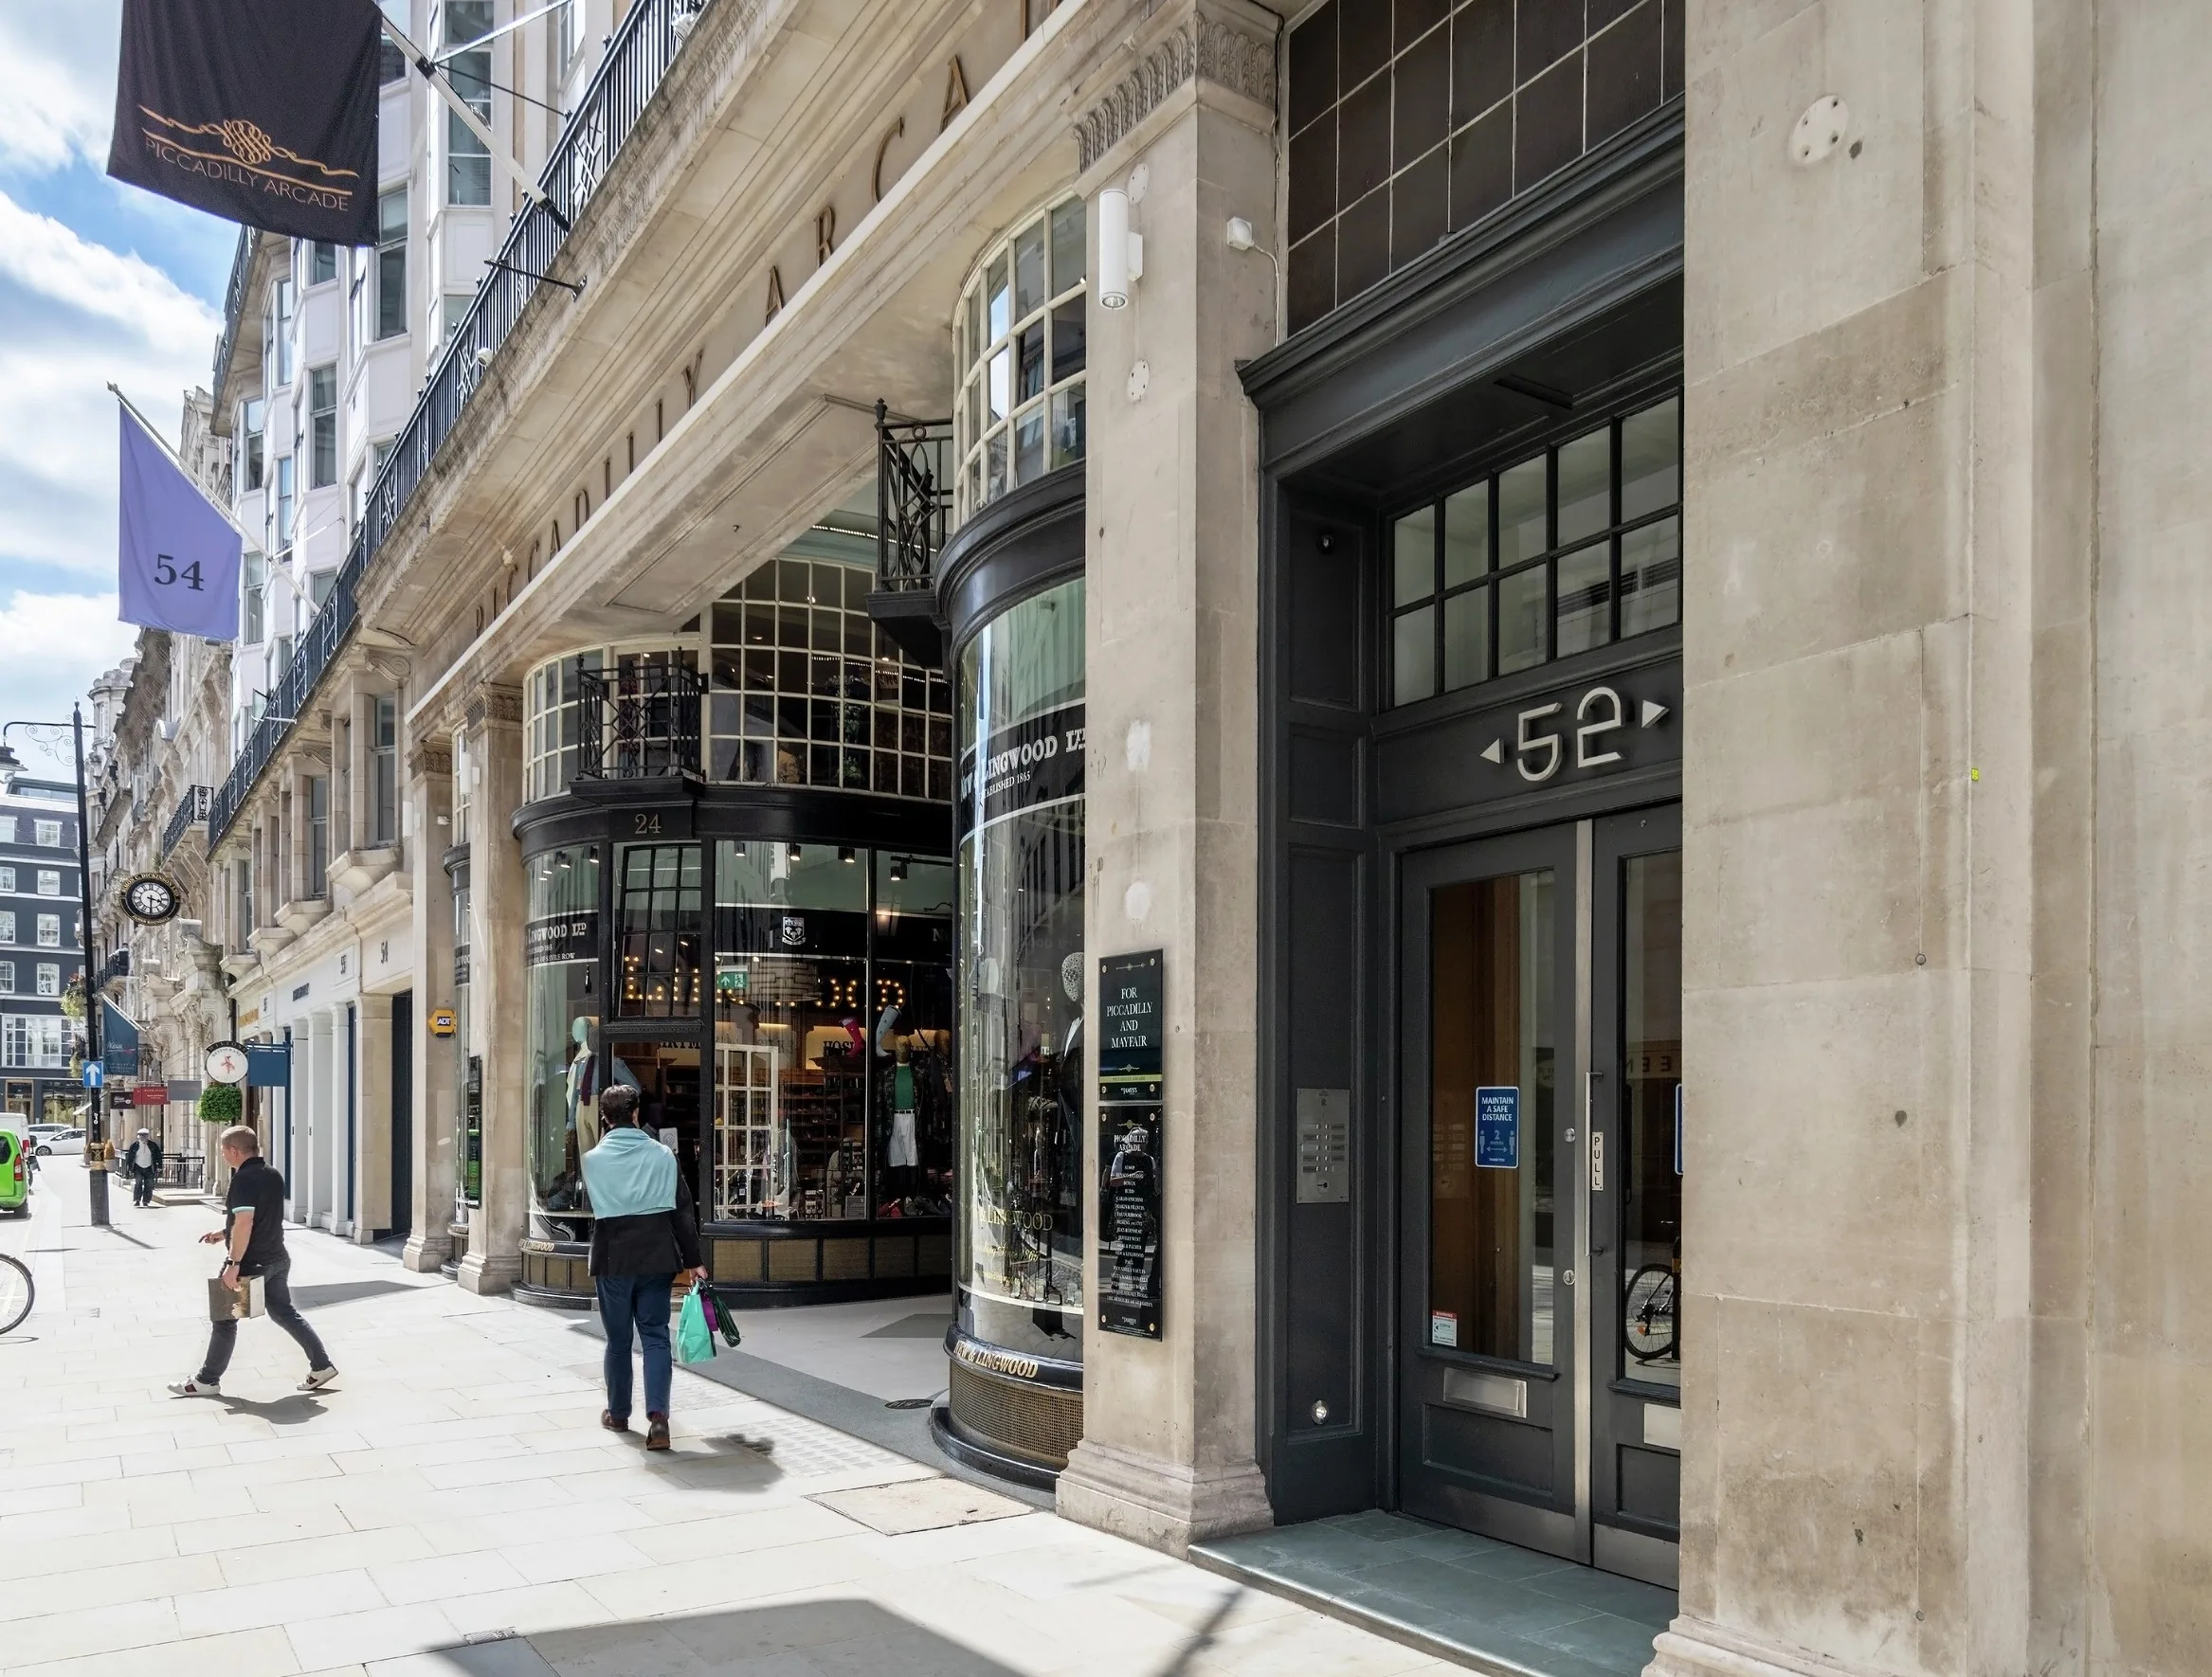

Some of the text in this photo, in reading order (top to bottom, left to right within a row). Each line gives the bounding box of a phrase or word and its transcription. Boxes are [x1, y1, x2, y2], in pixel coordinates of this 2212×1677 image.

[146, 138, 349, 211] PICCADILLY ARCADE
[154, 553, 204, 591] 54
[1517, 687, 1623, 782] 52
[1017, 771, 1030, 784] 1865
[635, 814, 662, 834] 24
[1121, 987, 1137, 999] FOR
[1107, 1001, 1152, 1017] PICCADILLY
[1120, 1020, 1138, 1032] AND
[1112, 1036, 1147, 1048] MAYFAIR
[1486, 1105, 1509, 1113] A SAFE
[1482, 1113, 1513, 1122] DISTANCE
[1494, 1129, 1500, 1141] 2
[1119, 1144, 1142, 1152] ARCADE
[975, 1350, 1039, 1379] LINGWOOD
